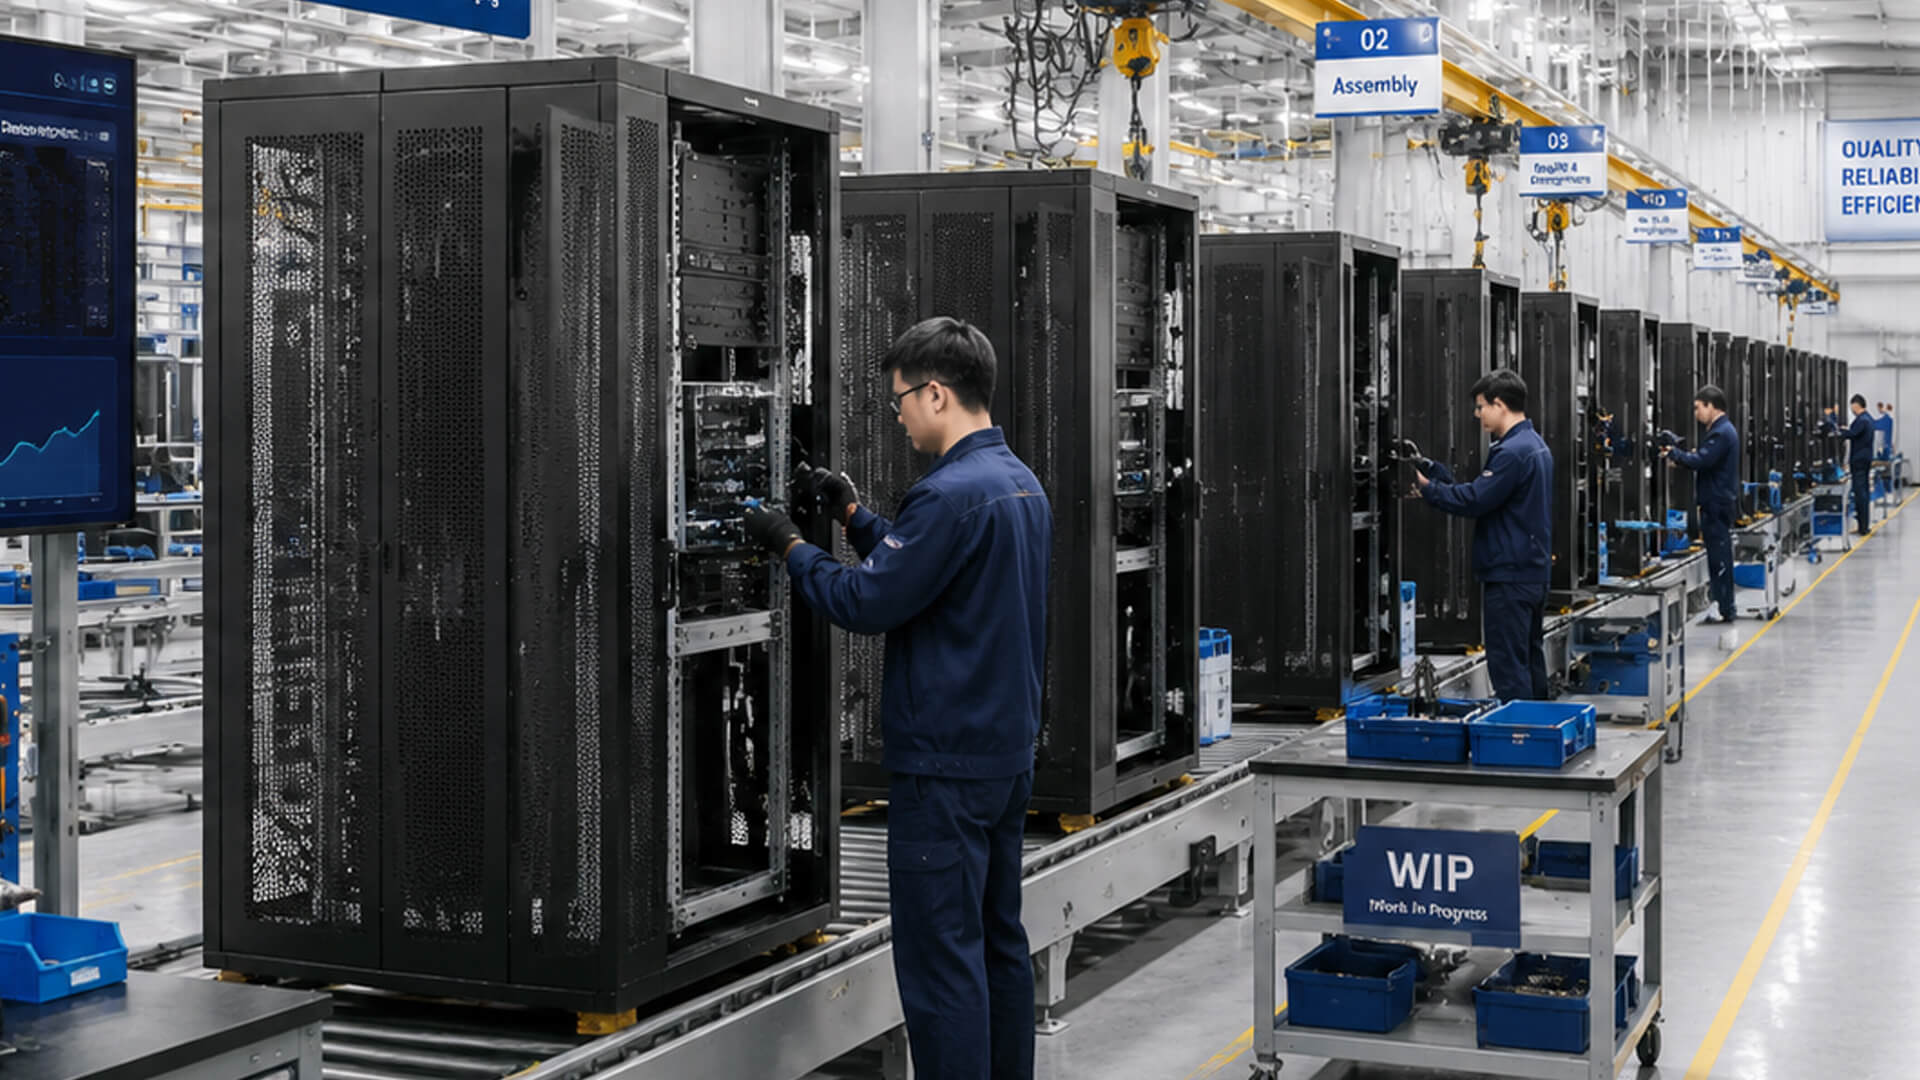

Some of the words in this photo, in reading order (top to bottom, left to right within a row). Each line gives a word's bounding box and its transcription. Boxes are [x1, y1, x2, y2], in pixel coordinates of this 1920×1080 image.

[1361, 28, 1389, 51] 02
[1332, 74, 1419, 98] Assembly
[1842, 166, 1919, 186] RELIABI
[1386, 850, 1474, 892] WIP
